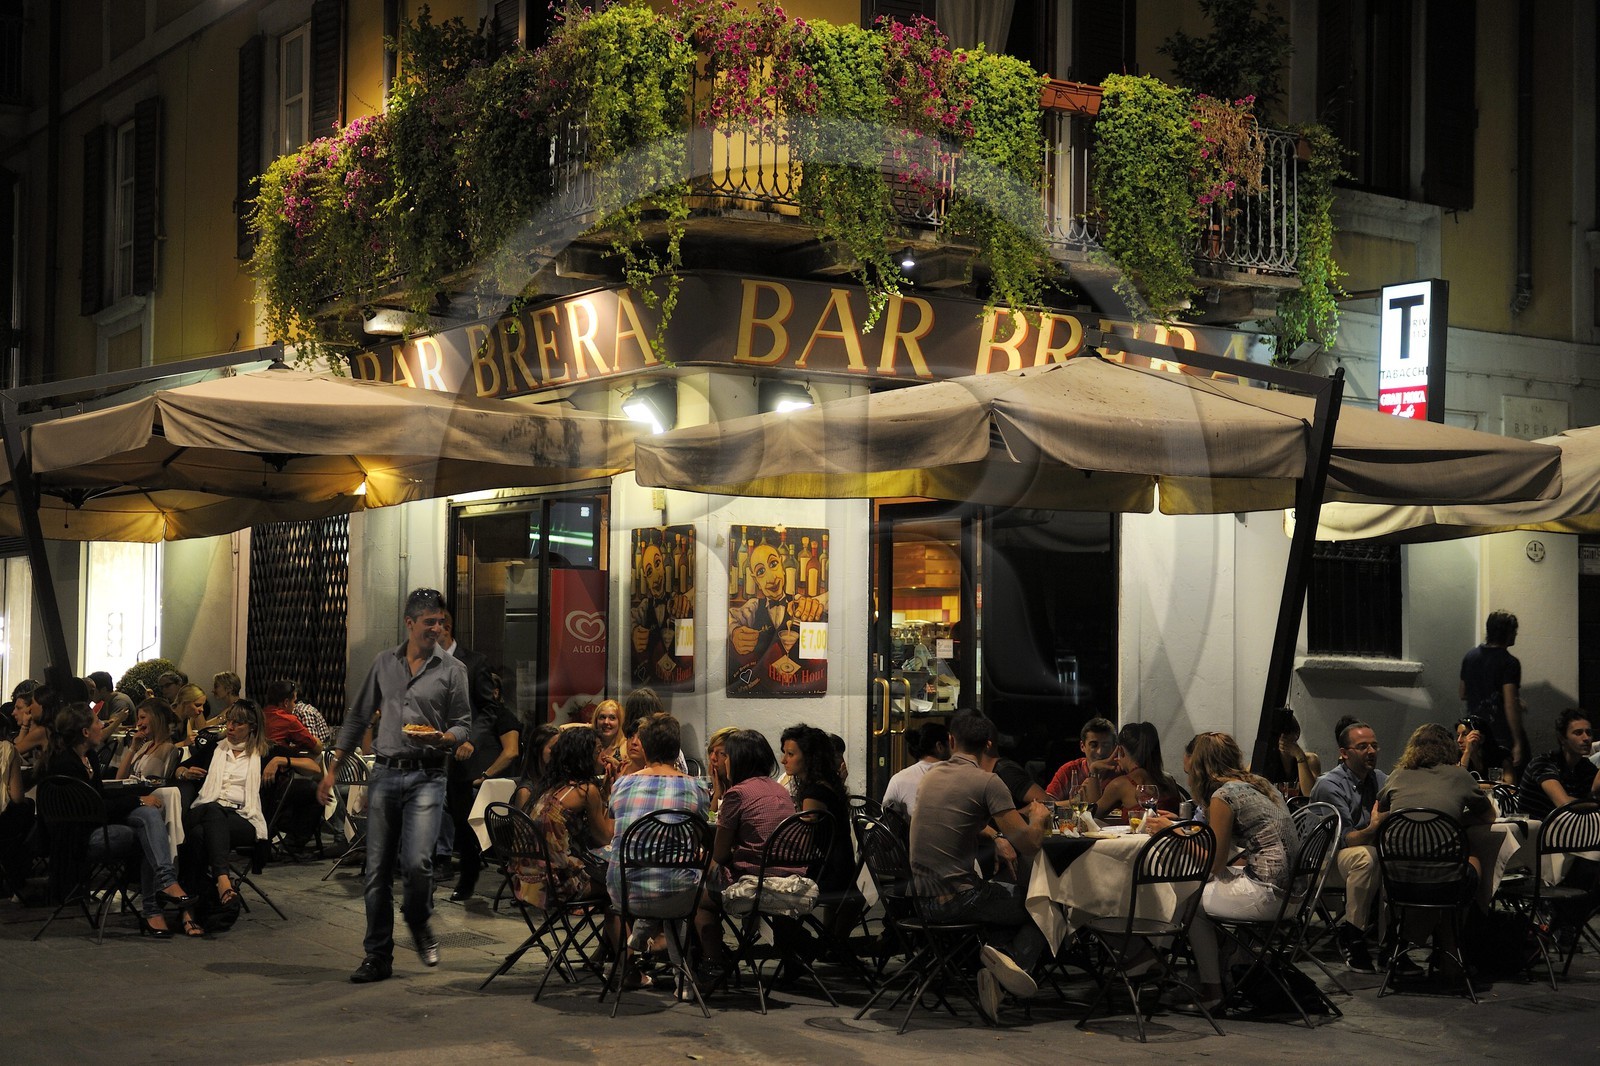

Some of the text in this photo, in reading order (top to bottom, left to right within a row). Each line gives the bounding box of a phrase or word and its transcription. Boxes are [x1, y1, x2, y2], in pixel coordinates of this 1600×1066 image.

[465, 288, 661, 399] BRERA
[734, 279, 936, 379] BAR
[1389, 293, 1425, 360] T
[1514, 422, 1558, 436] BRERA
[572, 645, 606, 653] ALGIDA
[769, 664, 799, 688] Happy
[801, 667, 825, 684] Hour
